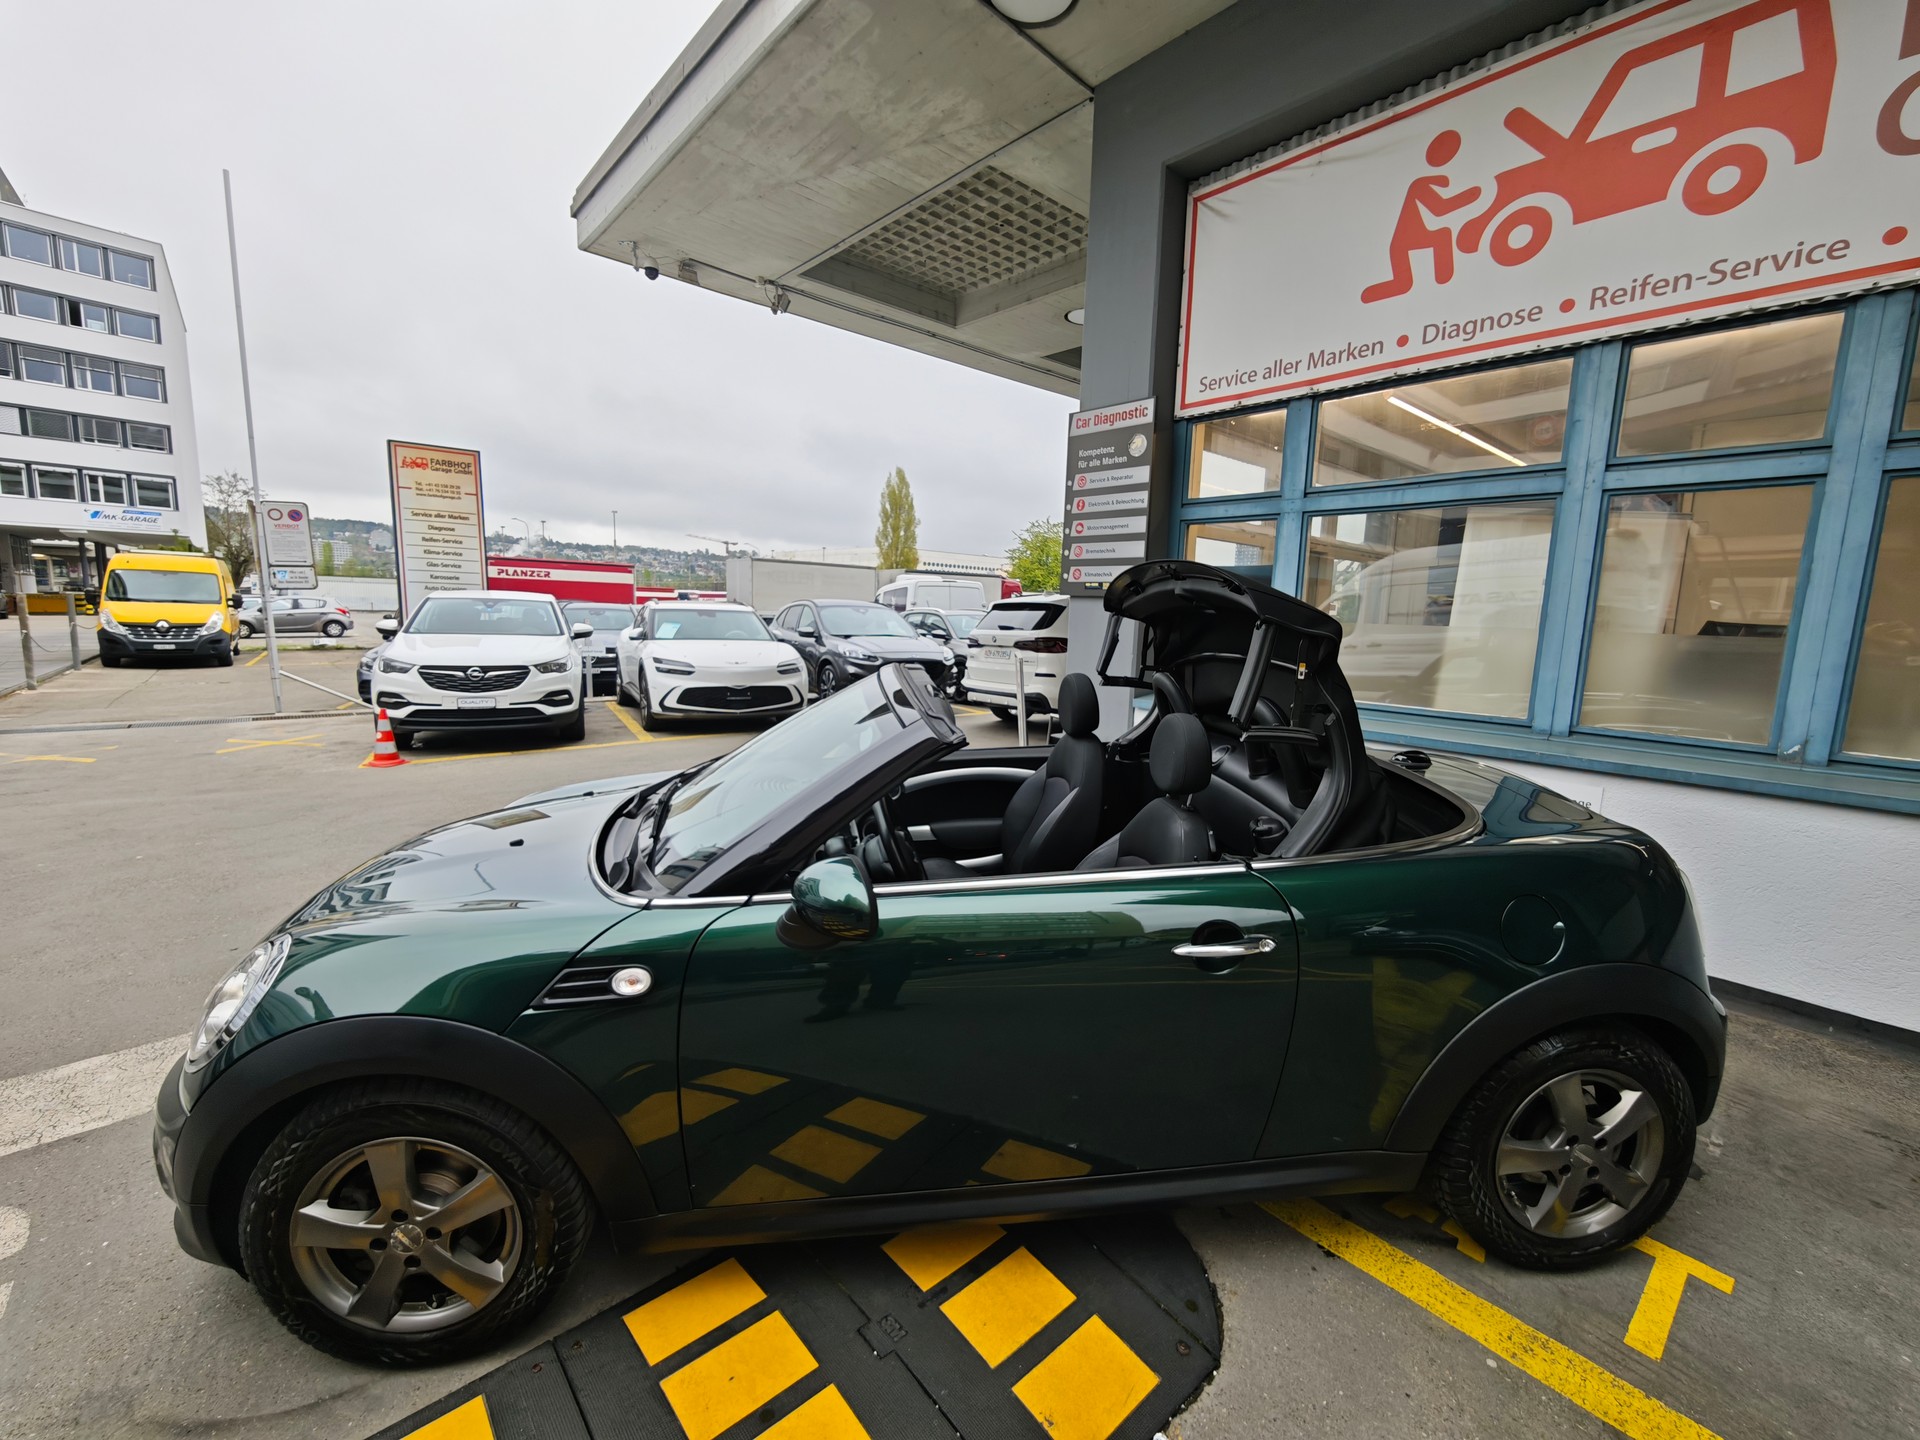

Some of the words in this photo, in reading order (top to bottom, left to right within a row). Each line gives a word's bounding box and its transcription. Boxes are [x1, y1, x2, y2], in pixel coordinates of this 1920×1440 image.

[1199, 369, 1257, 393] Service
[1263, 359, 1302, 381] aller
[1307, 338, 1385, 371] Marken
[1421, 305, 1543, 345] Diagnose
[1589, 239, 1851, 310] Reifen-Service
[1076, 418, 1091, 429] Car
[1094, 405, 1148, 426] Diagnostic
[1078, 446, 1115, 457] Kompetenz
[430, 458, 472, 470] FARBHOF
[1078, 460, 1087, 468] für
[1089, 458, 1101, 467] alle
[1102, 456, 1128, 465] Marken
[430, 466, 453, 474] Garage
[1111, 474, 1133, 482] Reparatur
[1088, 500, 1110, 508] Elektronik
[1116, 498, 1145, 506] Beleuchtung
[102, 513, 160, 524] MK-GARAGE
[427, 524, 455, 532] Diagnose
[1087, 523, 1129, 531] Motormanagement
[421, 536, 463, 545] Reifen-Service
[423, 549, 463, 557] Klima-Service
[426, 561, 462, 569] Glas-Service
[497, 568, 551, 578] PLANZER
